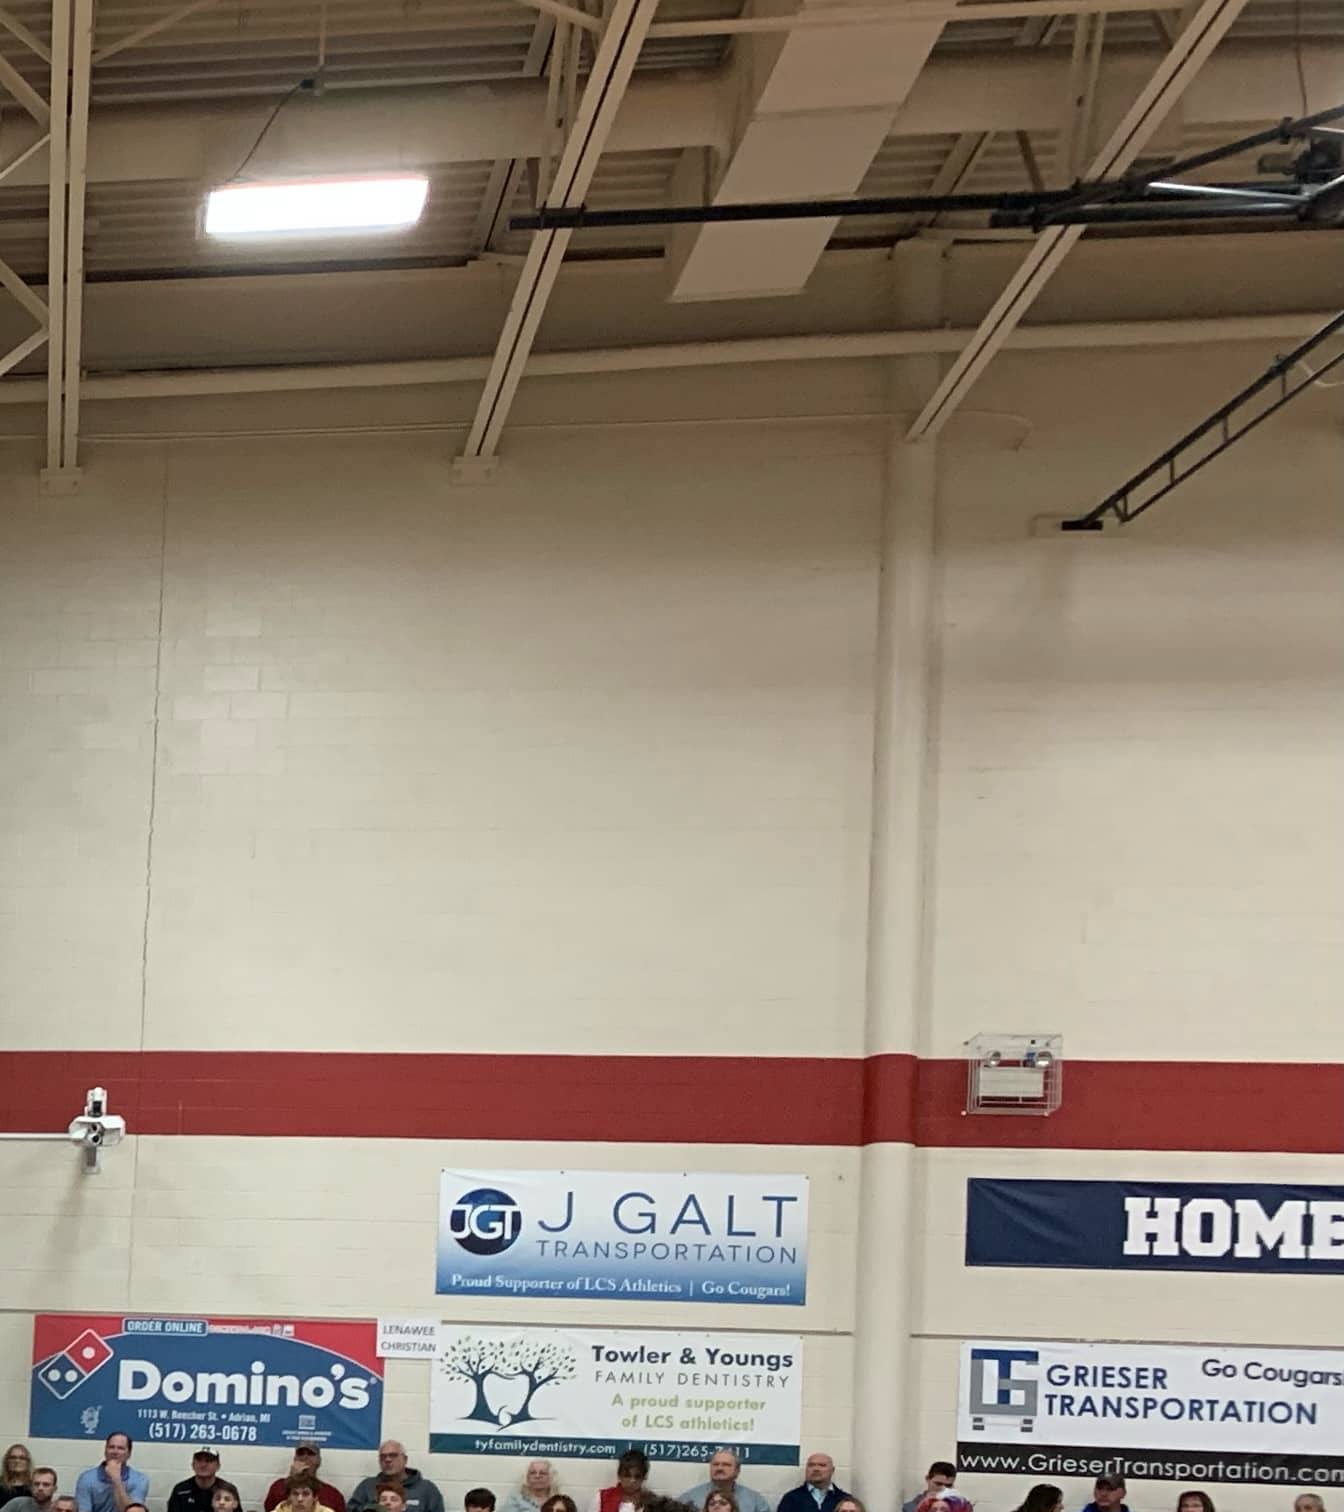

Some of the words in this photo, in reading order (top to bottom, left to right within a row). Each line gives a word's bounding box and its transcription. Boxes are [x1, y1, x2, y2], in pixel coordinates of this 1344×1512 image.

[450, 1205, 523, 1240] JGT
[538, 1191, 573, 1232] J
[613, 1192, 798, 1238] GALT
[1122, 1197, 1344, 1259] HOME
[537, 1240, 795, 1264] TRANSPORTATION
[452, 1273, 491, 1288] Proud
[495, 1275, 563, 1291] Supporter
[567, 1277, 583, 1290] of
[585, 1277, 615, 1291] LCS
[621, 1279, 681, 1293] Athletics
[702, 1281, 724, 1294] Go
[728, 1282, 791, 1298] Cougars!
[127, 1321, 162, 1332] ORDER
[164, 1322, 203, 1333] ONLINE
[383, 1326, 435, 1337] LENAWEE
[381, 1341, 436, 1352] CHRISTIAN
[592, 1345, 671, 1365] Towler
[679, 1348, 695, 1365] &
[707, 1350, 793, 1370] Youngs
[1046, 1364, 1168, 1390] GRIESER
[1202, 1358, 1237, 1378] Go
[118, 1360, 370, 1409] Domino's
[595, 1371, 665, 1384] FAMILY
[678, 1373, 789, 1389] DENTISTRY
[612, 1394, 624, 1406] A
[630, 1395, 679, 1410] proud
[686, 1397, 766, 1412] supporter
[1044, 1394, 1317, 1425] TRANSPORTATION
[208, 1412, 218, 1421] St.
[260, 1414, 271, 1423] MI
[622, 1414, 638, 1428] of
[645, 1415, 673, 1429] LCS
[680, 1417, 754, 1431] athletics!
[149, 1423, 186, 1440] (517)
[190, 1425, 256, 1441] 263-0678
[474, 1438, 616, 1457] tyfamilydentistry.com
